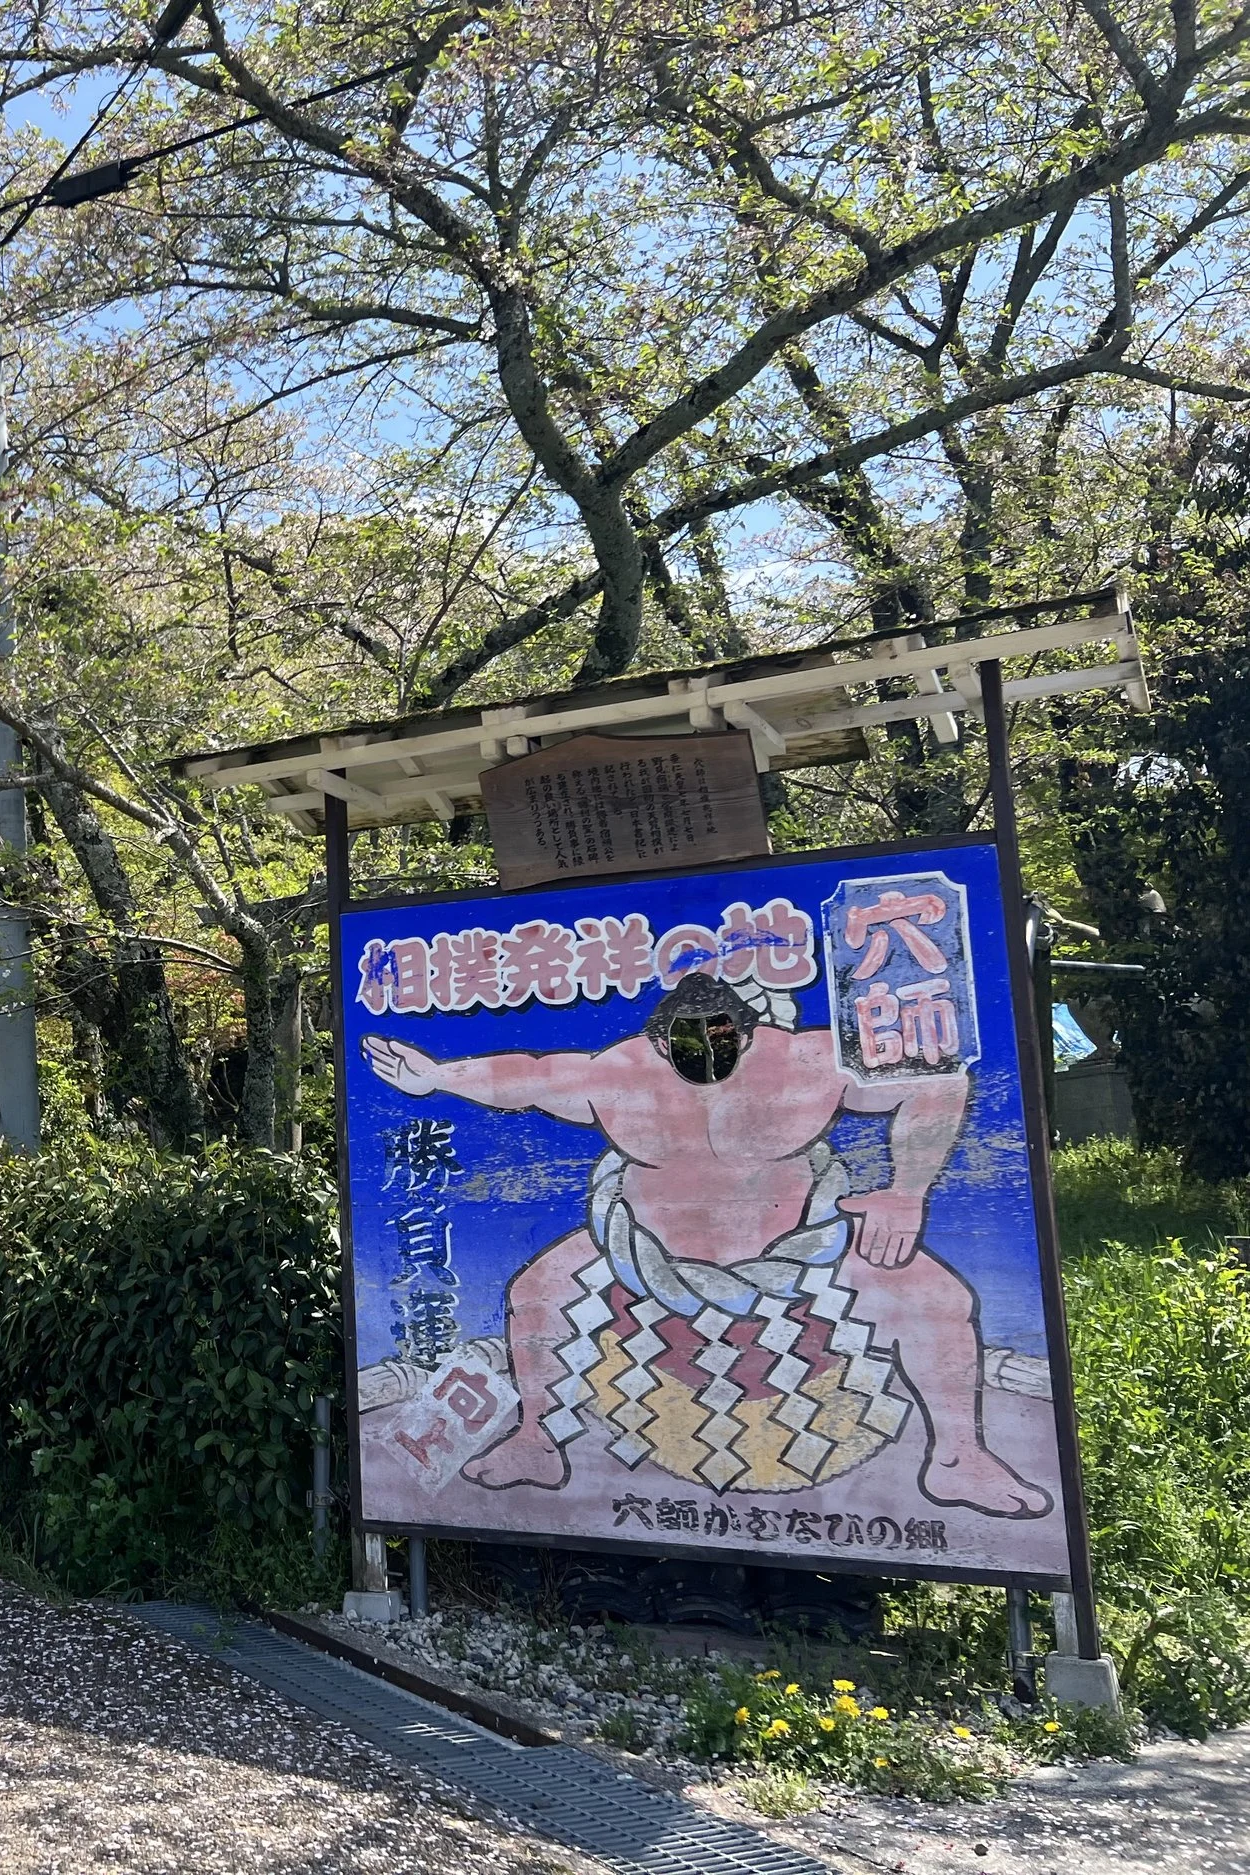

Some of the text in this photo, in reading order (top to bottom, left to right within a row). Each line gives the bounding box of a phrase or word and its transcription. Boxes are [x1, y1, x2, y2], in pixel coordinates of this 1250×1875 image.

[358, 898, 817, 1016] 相撲発祥の地
[845, 891, 960, 1068] 穴師
[380, 1118, 465, 1371] 勝負運
